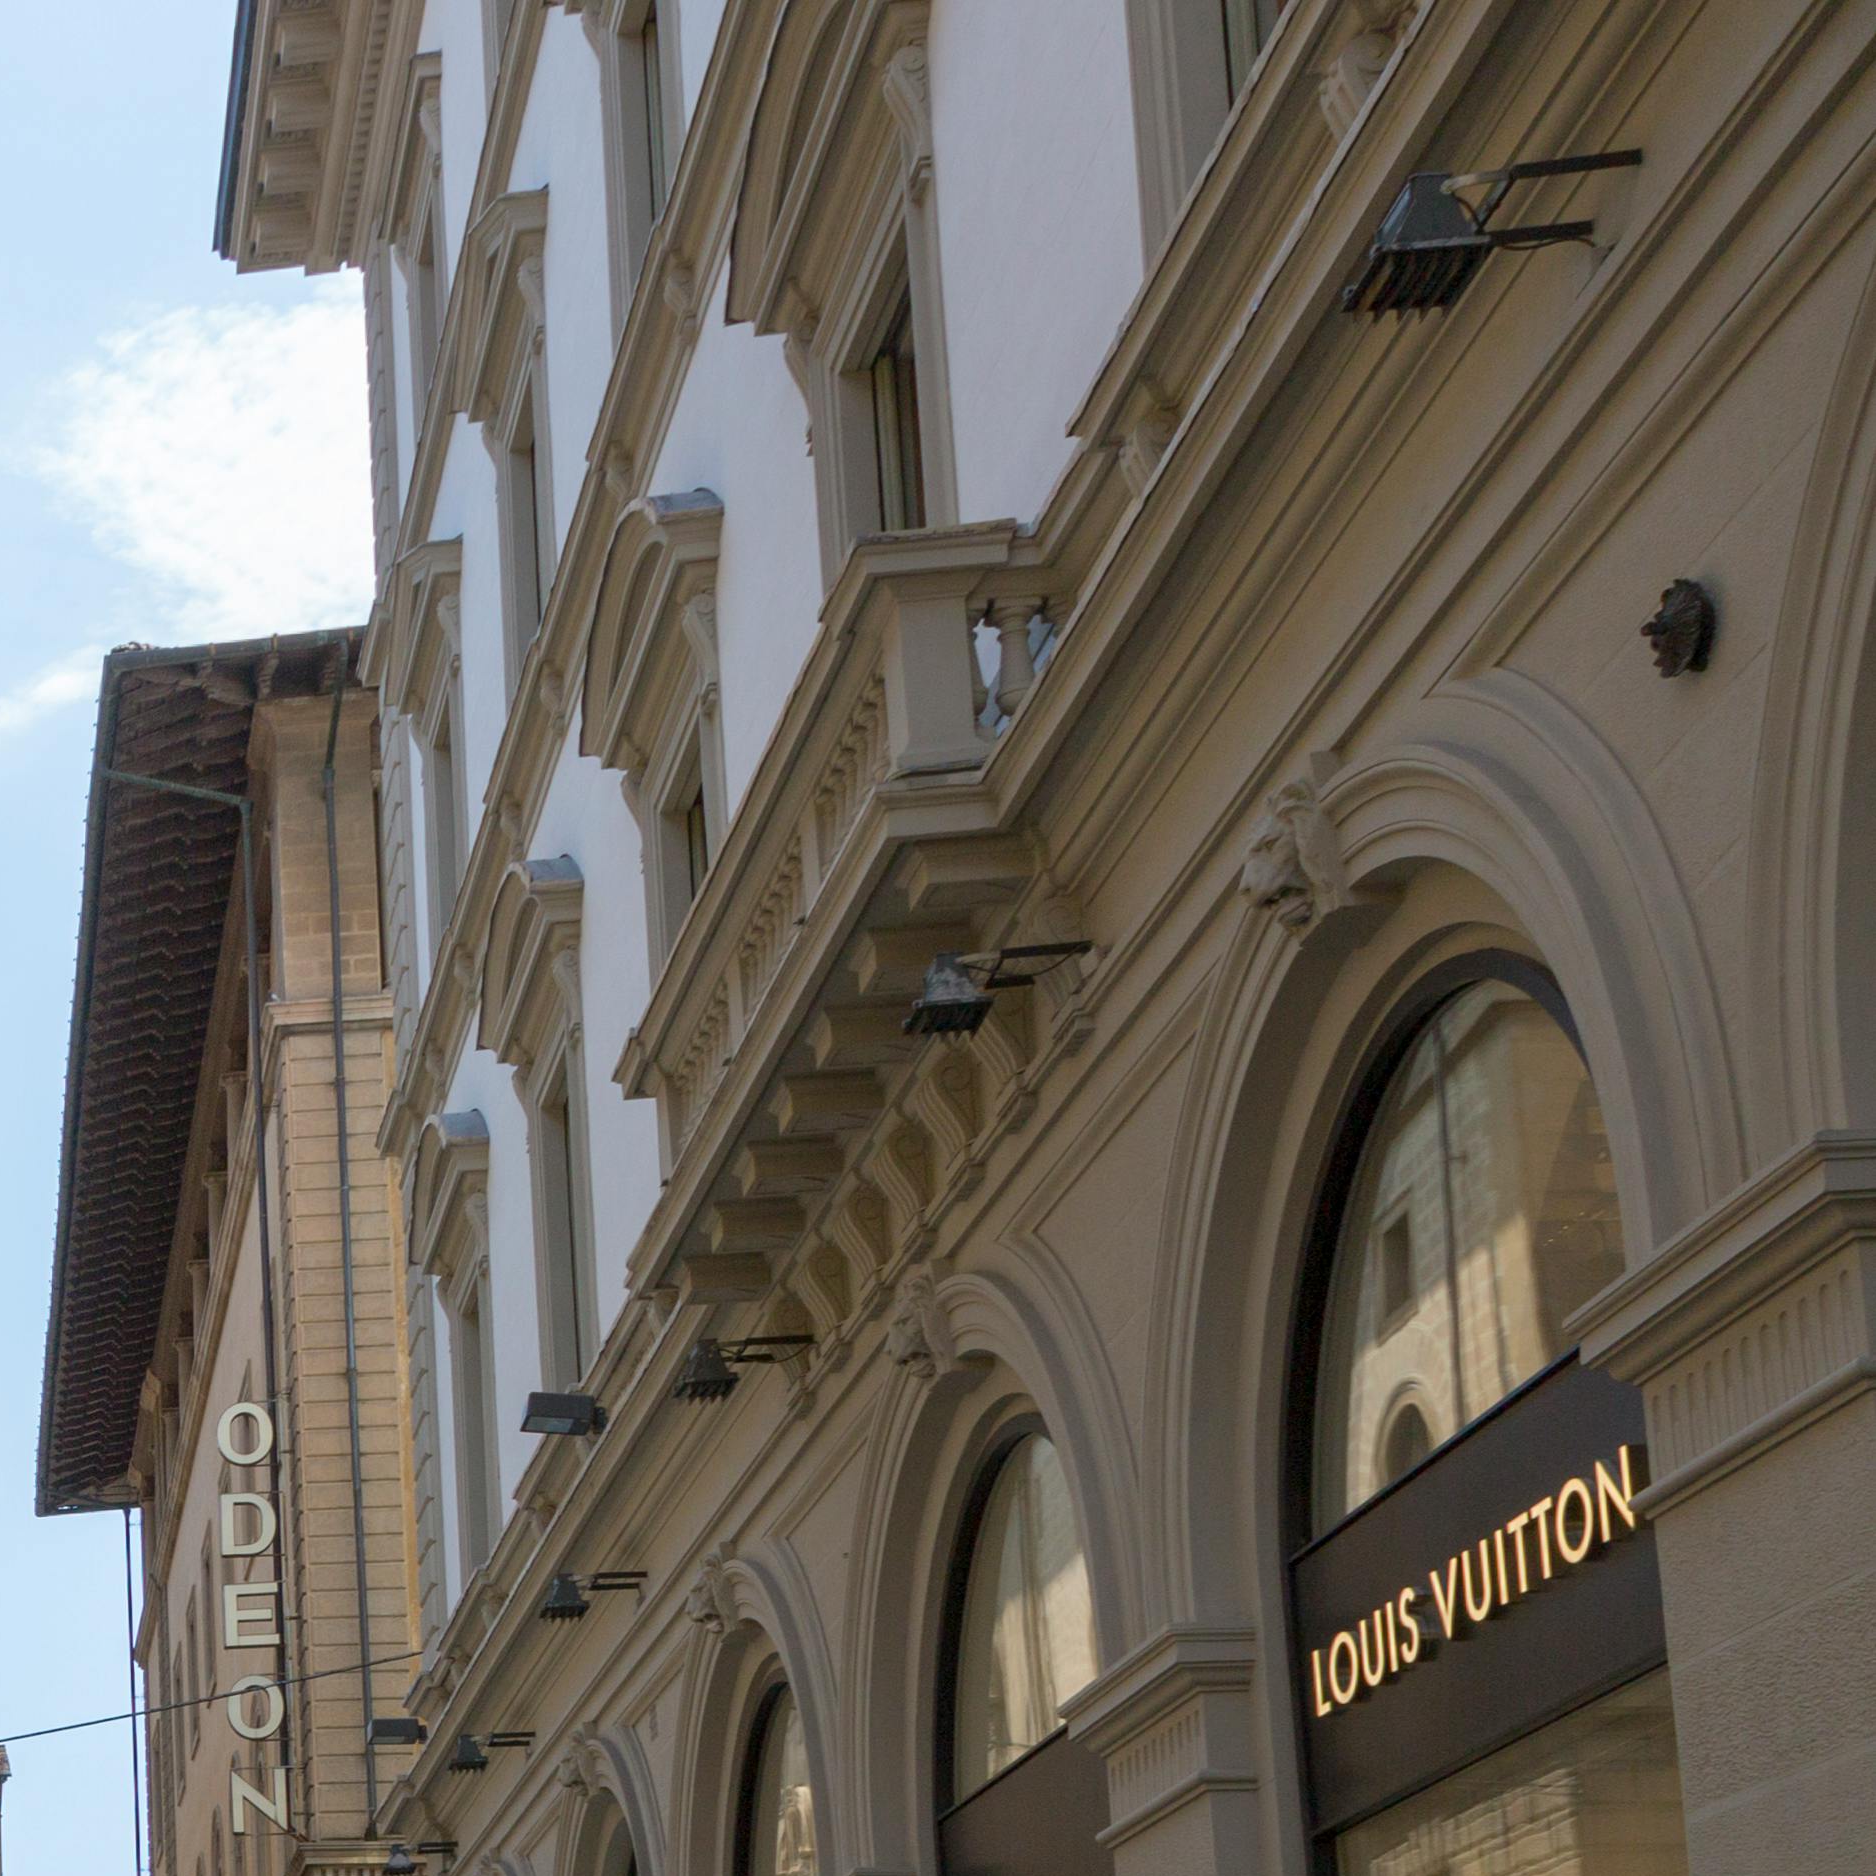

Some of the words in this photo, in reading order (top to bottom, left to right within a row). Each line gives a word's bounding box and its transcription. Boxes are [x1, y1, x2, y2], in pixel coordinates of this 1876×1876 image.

[216, 1401, 291, 1836] ODEON
[1310, 1586, 1420, 1718] LOUIS
[1428, 1444, 1636, 1640] VUITTON
